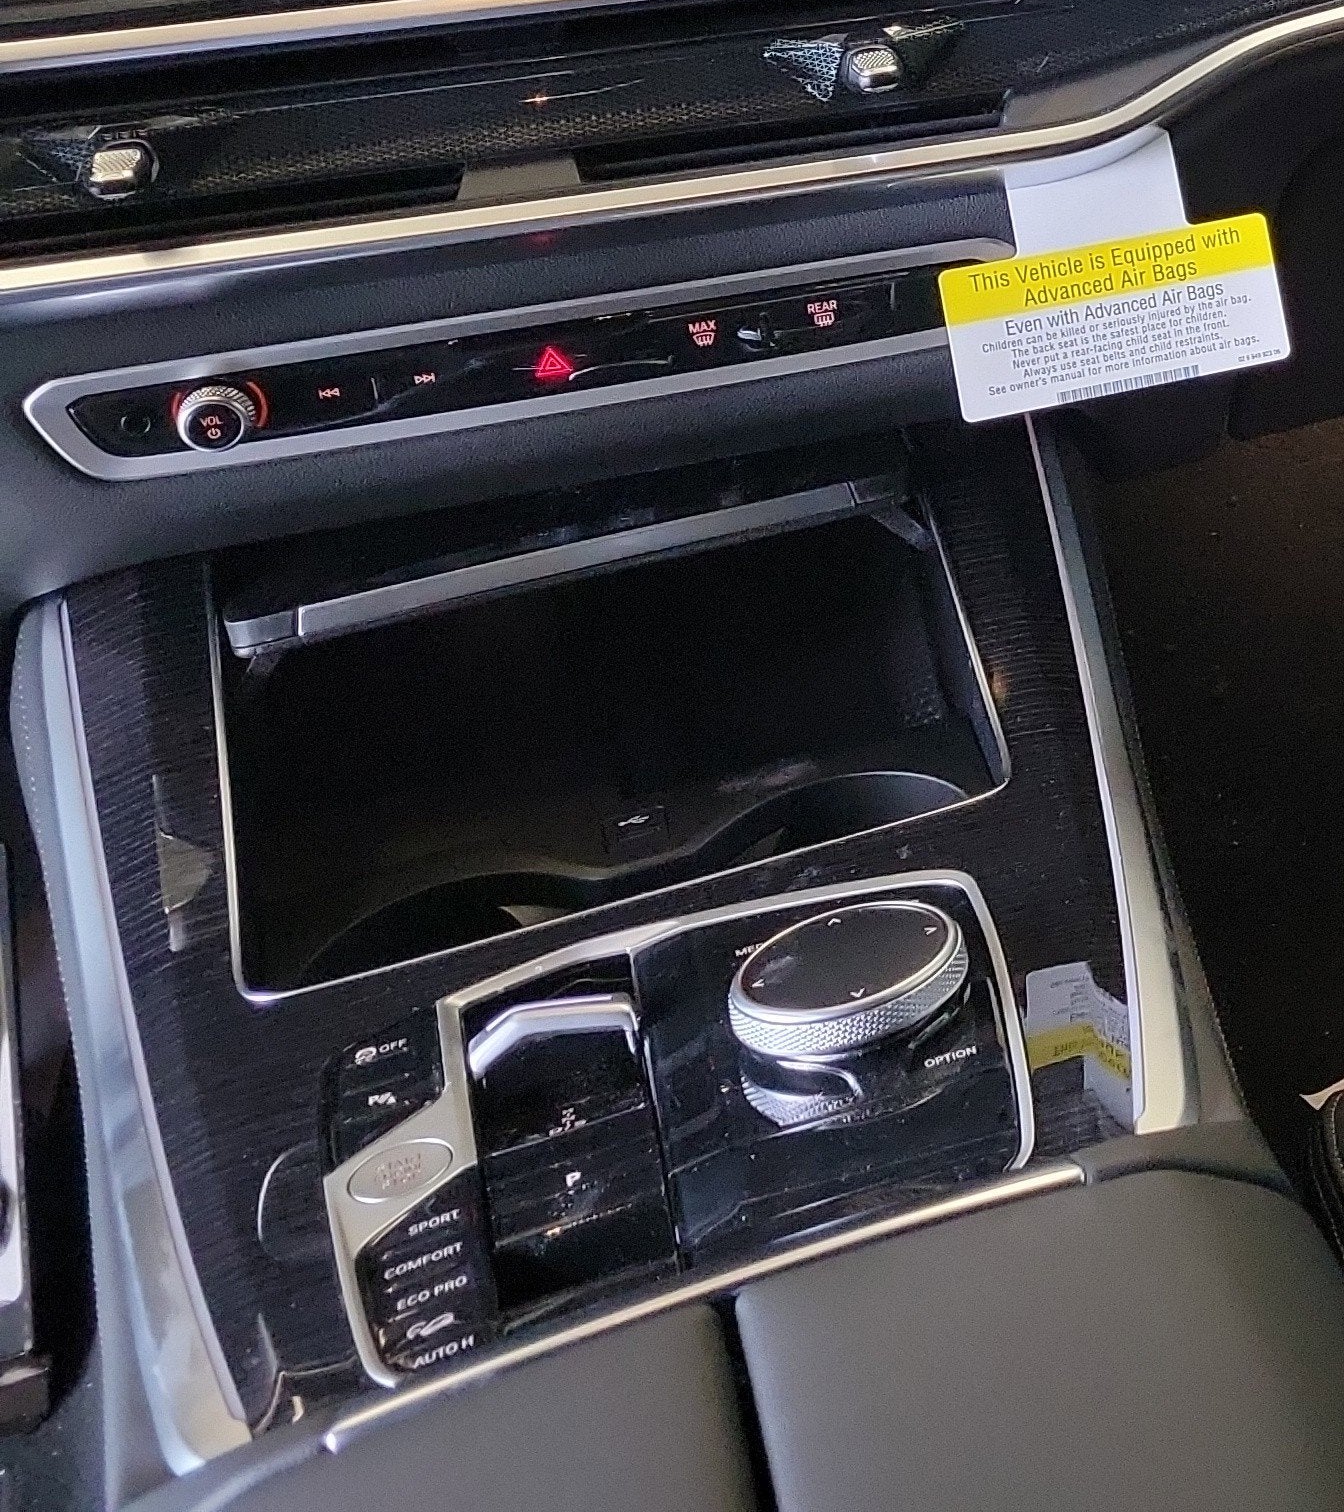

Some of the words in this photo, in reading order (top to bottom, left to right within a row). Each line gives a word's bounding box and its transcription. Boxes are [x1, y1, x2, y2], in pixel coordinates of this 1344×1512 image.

[968, 269, 1011, 294] This
[1013, 257, 1084, 287] Vehicle
[1089, 252, 1106, 271] is
[1111, 236, 1197, 269] Equipped
[1201, 225, 1242, 251] with
[1023, 276, 1115, 308] Advanced
[1121, 266, 1147, 290] Air
[1153, 259, 1198, 287] Bags
[806, 299, 839, 315] REAR
[981, 337, 1024, 354] Children
[1026, 334, 1044, 346] can
[1046, 329, 1059, 342] be
[1061, 322, 1087, 338] killed
[1089, 322, 1101, 332] or
[1103, 313, 1147, 331] seriously
[1148, 305, 1182, 324] injured
[1184, 302, 1196, 317] by
[1198, 299, 1213, 312] the
[1215, 295, 1228, 308] air
[1230, 292, 1252, 308] bag.
[1004, 317, 1043, 337] Even
[1046, 309, 1080, 328] with
[1084, 295, 1158, 321] Advanced
[1162, 287, 1183, 306] Air
[1187, 281, 1224, 303] Bags
[687, 319, 717, 334] MAX
[1012, 346, 1029, 359] The
[1032, 341, 1056, 356] back
[1058, 337, 1078, 350] seat
[1081, 334, 1090, 346] is
[1092, 330, 1108, 344] the
[1110, 323, 1140, 340] safest
[1142, 318, 1167, 336] place
[1169, 315, 1184, 328] for
[1185, 308, 1228, 326] children.
[1012, 355, 1041, 370] Never
[1043, 352, 1060, 367] put
[1062, 351, 1069, 361] a
[1071, 340, 1123, 359] rear-facing
[1125, 333, 1149, 348] child
[1152, 329, 1172, 342] seat
[1174, 328, 1184, 339] in
[1186, 324, 1201, 337] the
[1203, 319, 1230, 333] front.
[987, 383, 1008, 397] See
[1010, 374, 1048, 393] owner's
[1050, 367, 1086, 384] manual
[1087, 364, 1103, 378] for
[1105, 362, 1130, 375] more
[1131, 348, 1188, 370] information
[1190, 341, 1217, 357] about
[1219, 337, 1233, 352] air
[1234, 334, 1261, 350] bags.
[1023, 363, 1058, 380] Always
[1061, 360, 1078, 372] use
[1080, 355, 1100, 368] seat
[1102, 349, 1126, 364] belts
[1129, 344, 1147, 359] and
[1148, 340, 1173, 355] child
[1174, 330, 1224, 350] restraints.
[200, 414, 224, 428] VOL
[379, 1037, 408, 1055] OFF
[922, 1044, 979, 1070] OPTION
[565, 1171, 582, 1188] P
[406, 1207, 462, 1237] SPORT
[384, 1242, 463, 1280] COMFORT
[396, 1287, 430, 1312] ECO
[433, 1274, 469, 1300] PRO
[412, 1340, 458, 1370] AUTO
[461, 1334, 476, 1351] H
